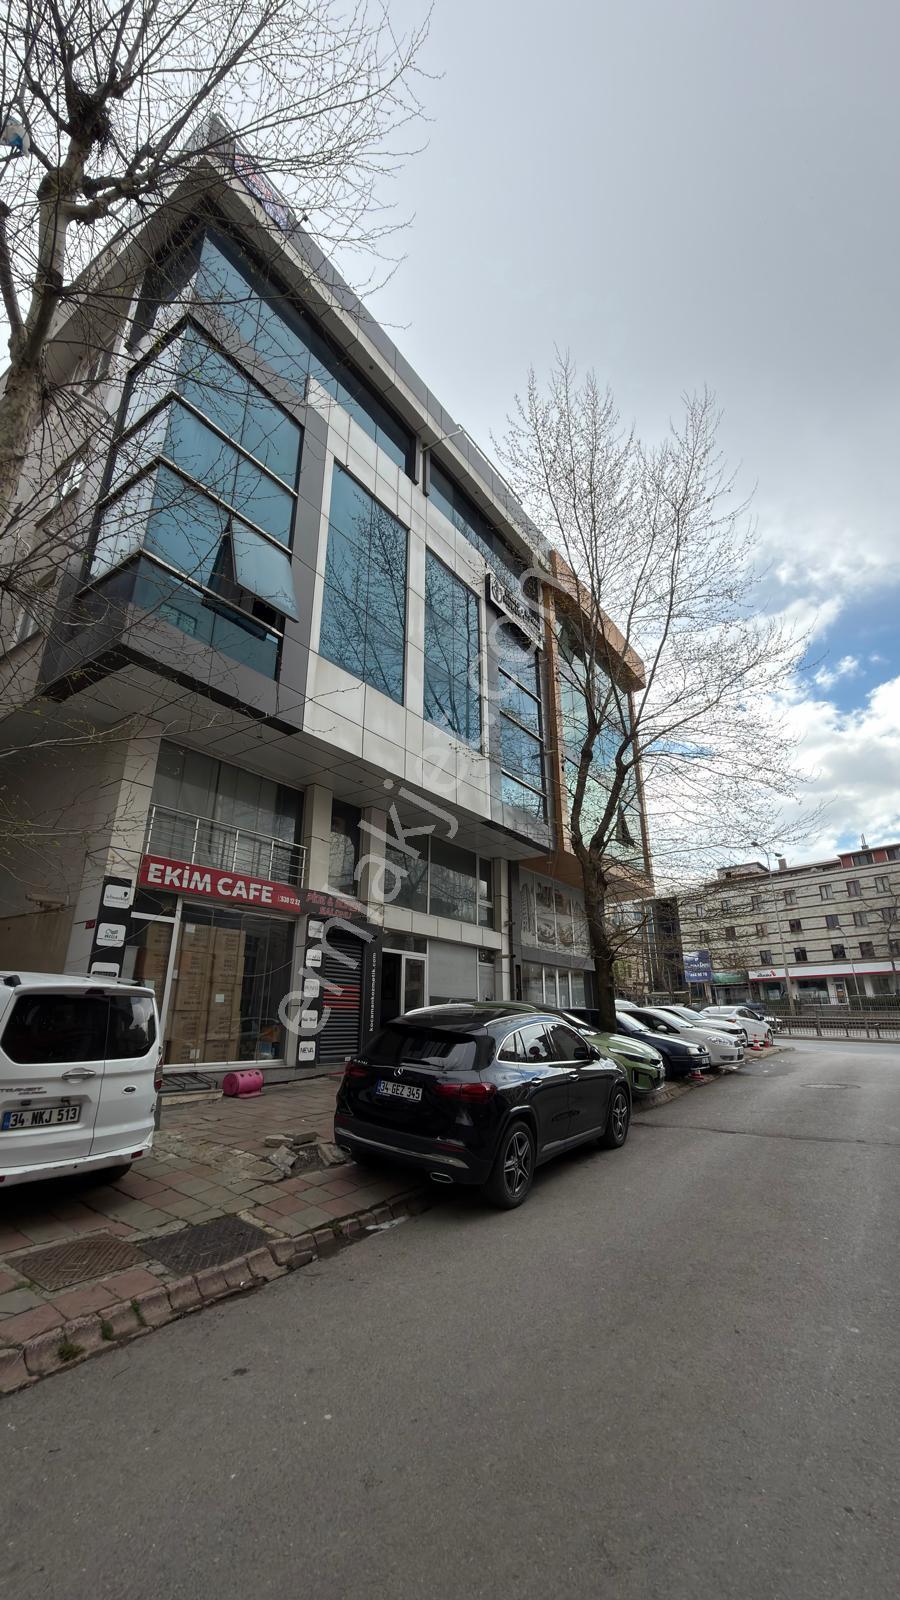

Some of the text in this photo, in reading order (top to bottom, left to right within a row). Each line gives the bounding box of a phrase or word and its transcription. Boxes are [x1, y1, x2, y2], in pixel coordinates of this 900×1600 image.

[147, 863, 212, 893] EKİM
[216, 876, 274, 904] CAFE
[380, 1081, 420, 1099] 34 GEZ 345
[10, 1108, 77, 1127] 34 NKJ 513
